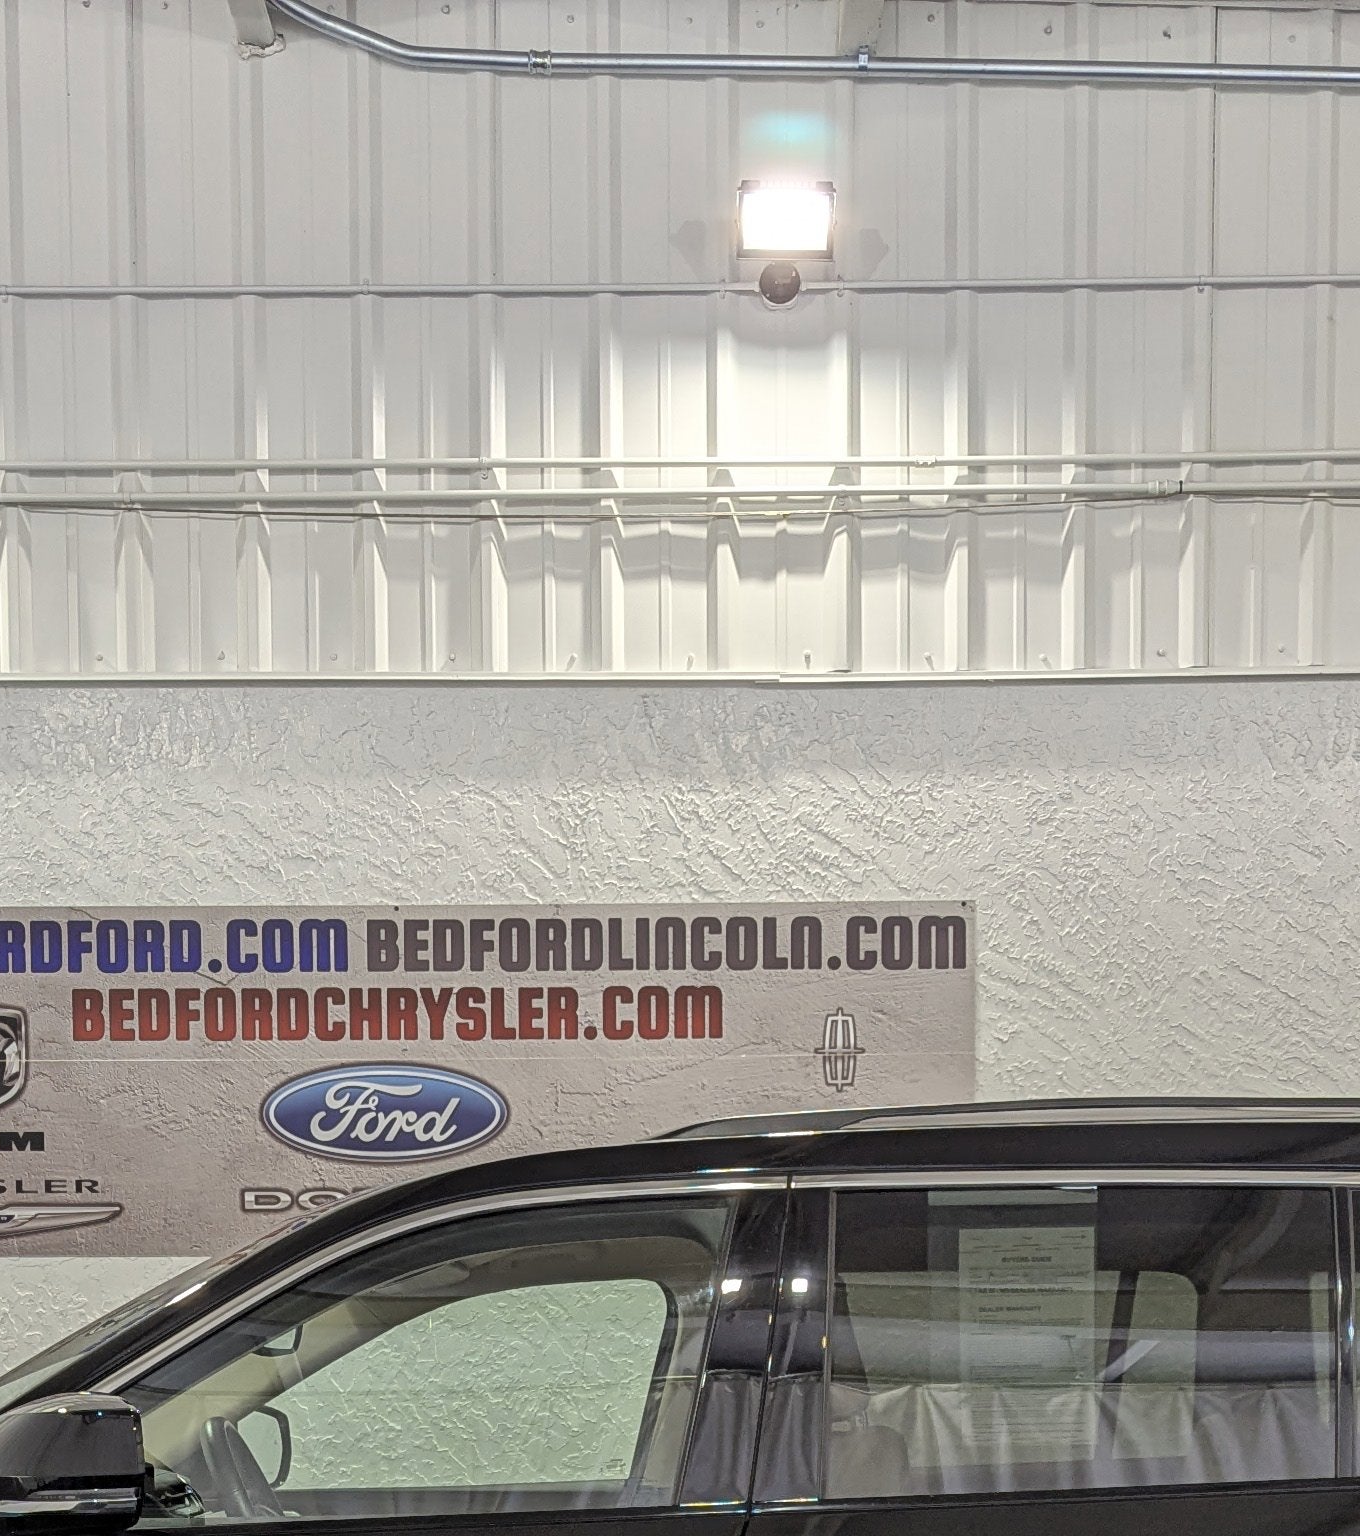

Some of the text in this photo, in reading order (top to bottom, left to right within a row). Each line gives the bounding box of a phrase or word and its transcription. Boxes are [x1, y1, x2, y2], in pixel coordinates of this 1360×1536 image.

[366, 915, 967, 972] BEDFORDLINCOLN.COM
[71, 985, 723, 1042] BEDFORDCHRYSLER.COM
[309, 1080, 461, 1143] Ford
